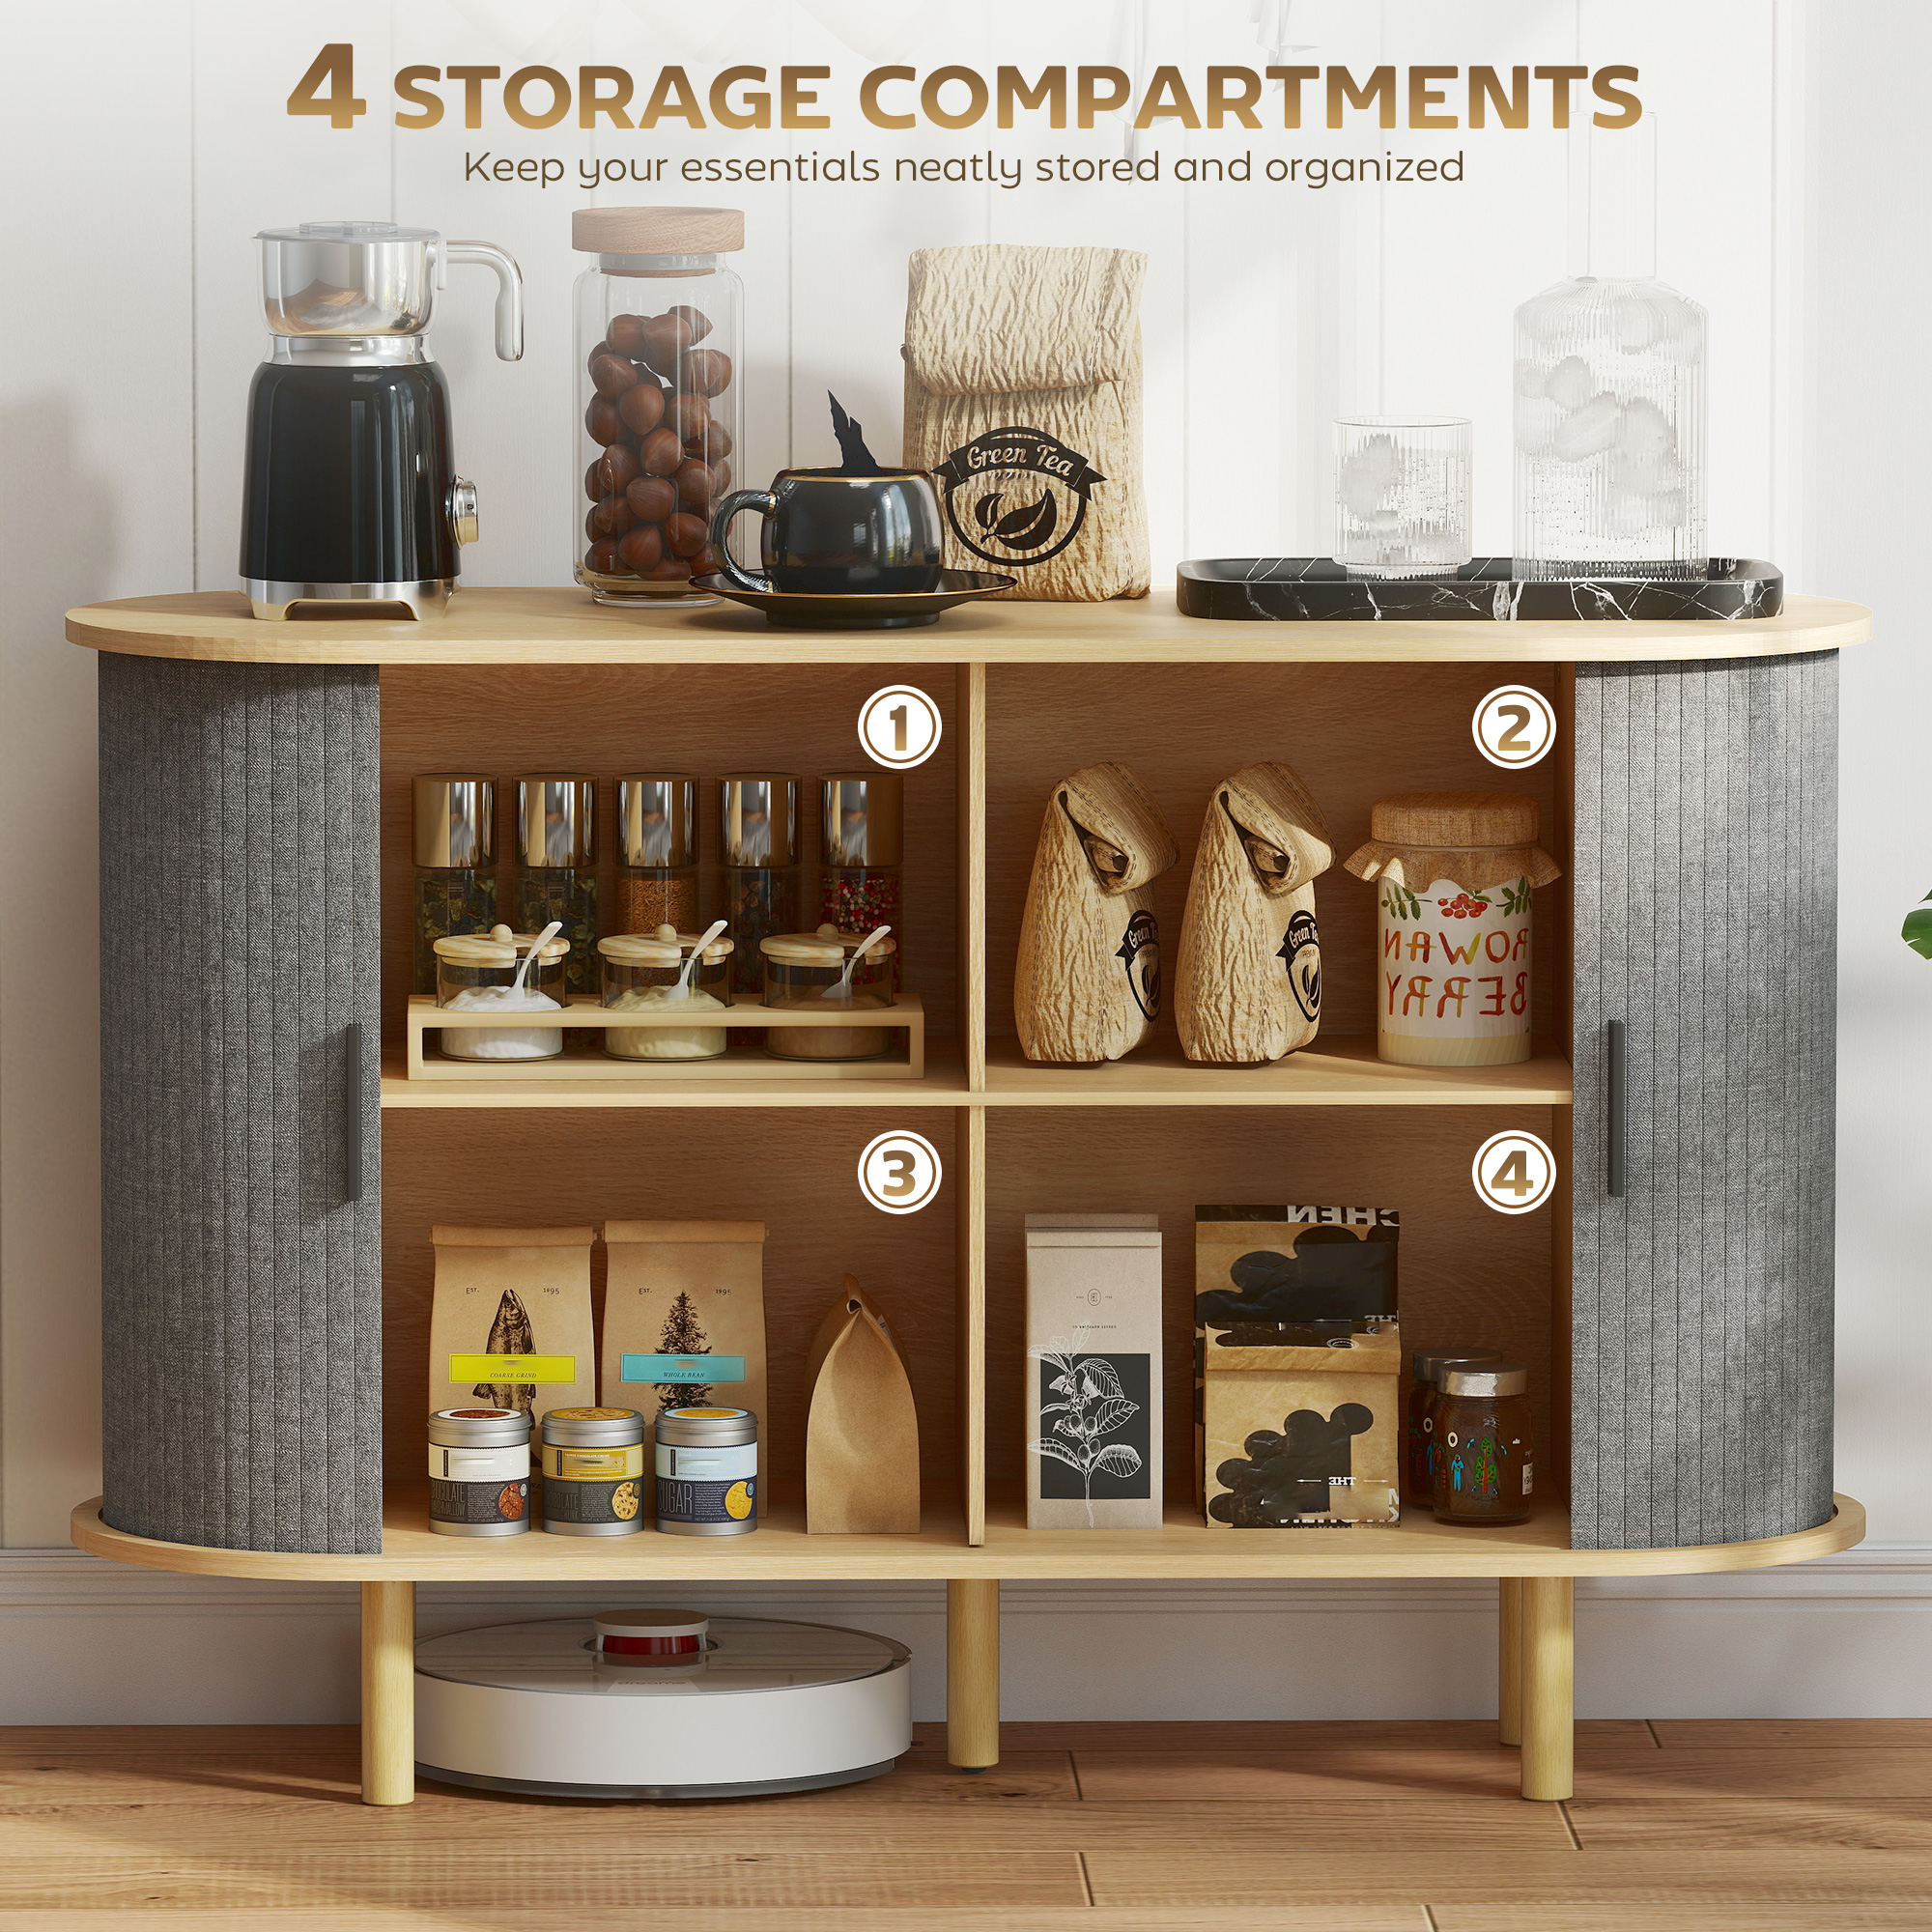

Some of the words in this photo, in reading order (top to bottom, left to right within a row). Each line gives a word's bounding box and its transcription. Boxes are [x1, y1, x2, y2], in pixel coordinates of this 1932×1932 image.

[967, 445, 1027, 469] Green
[1037, 444, 1074, 476] Tea
[1128, 927, 1150, 949] Green
[1289, 926, 1310, 949] Green
[657, 1480, 693, 1515] SUGAR
